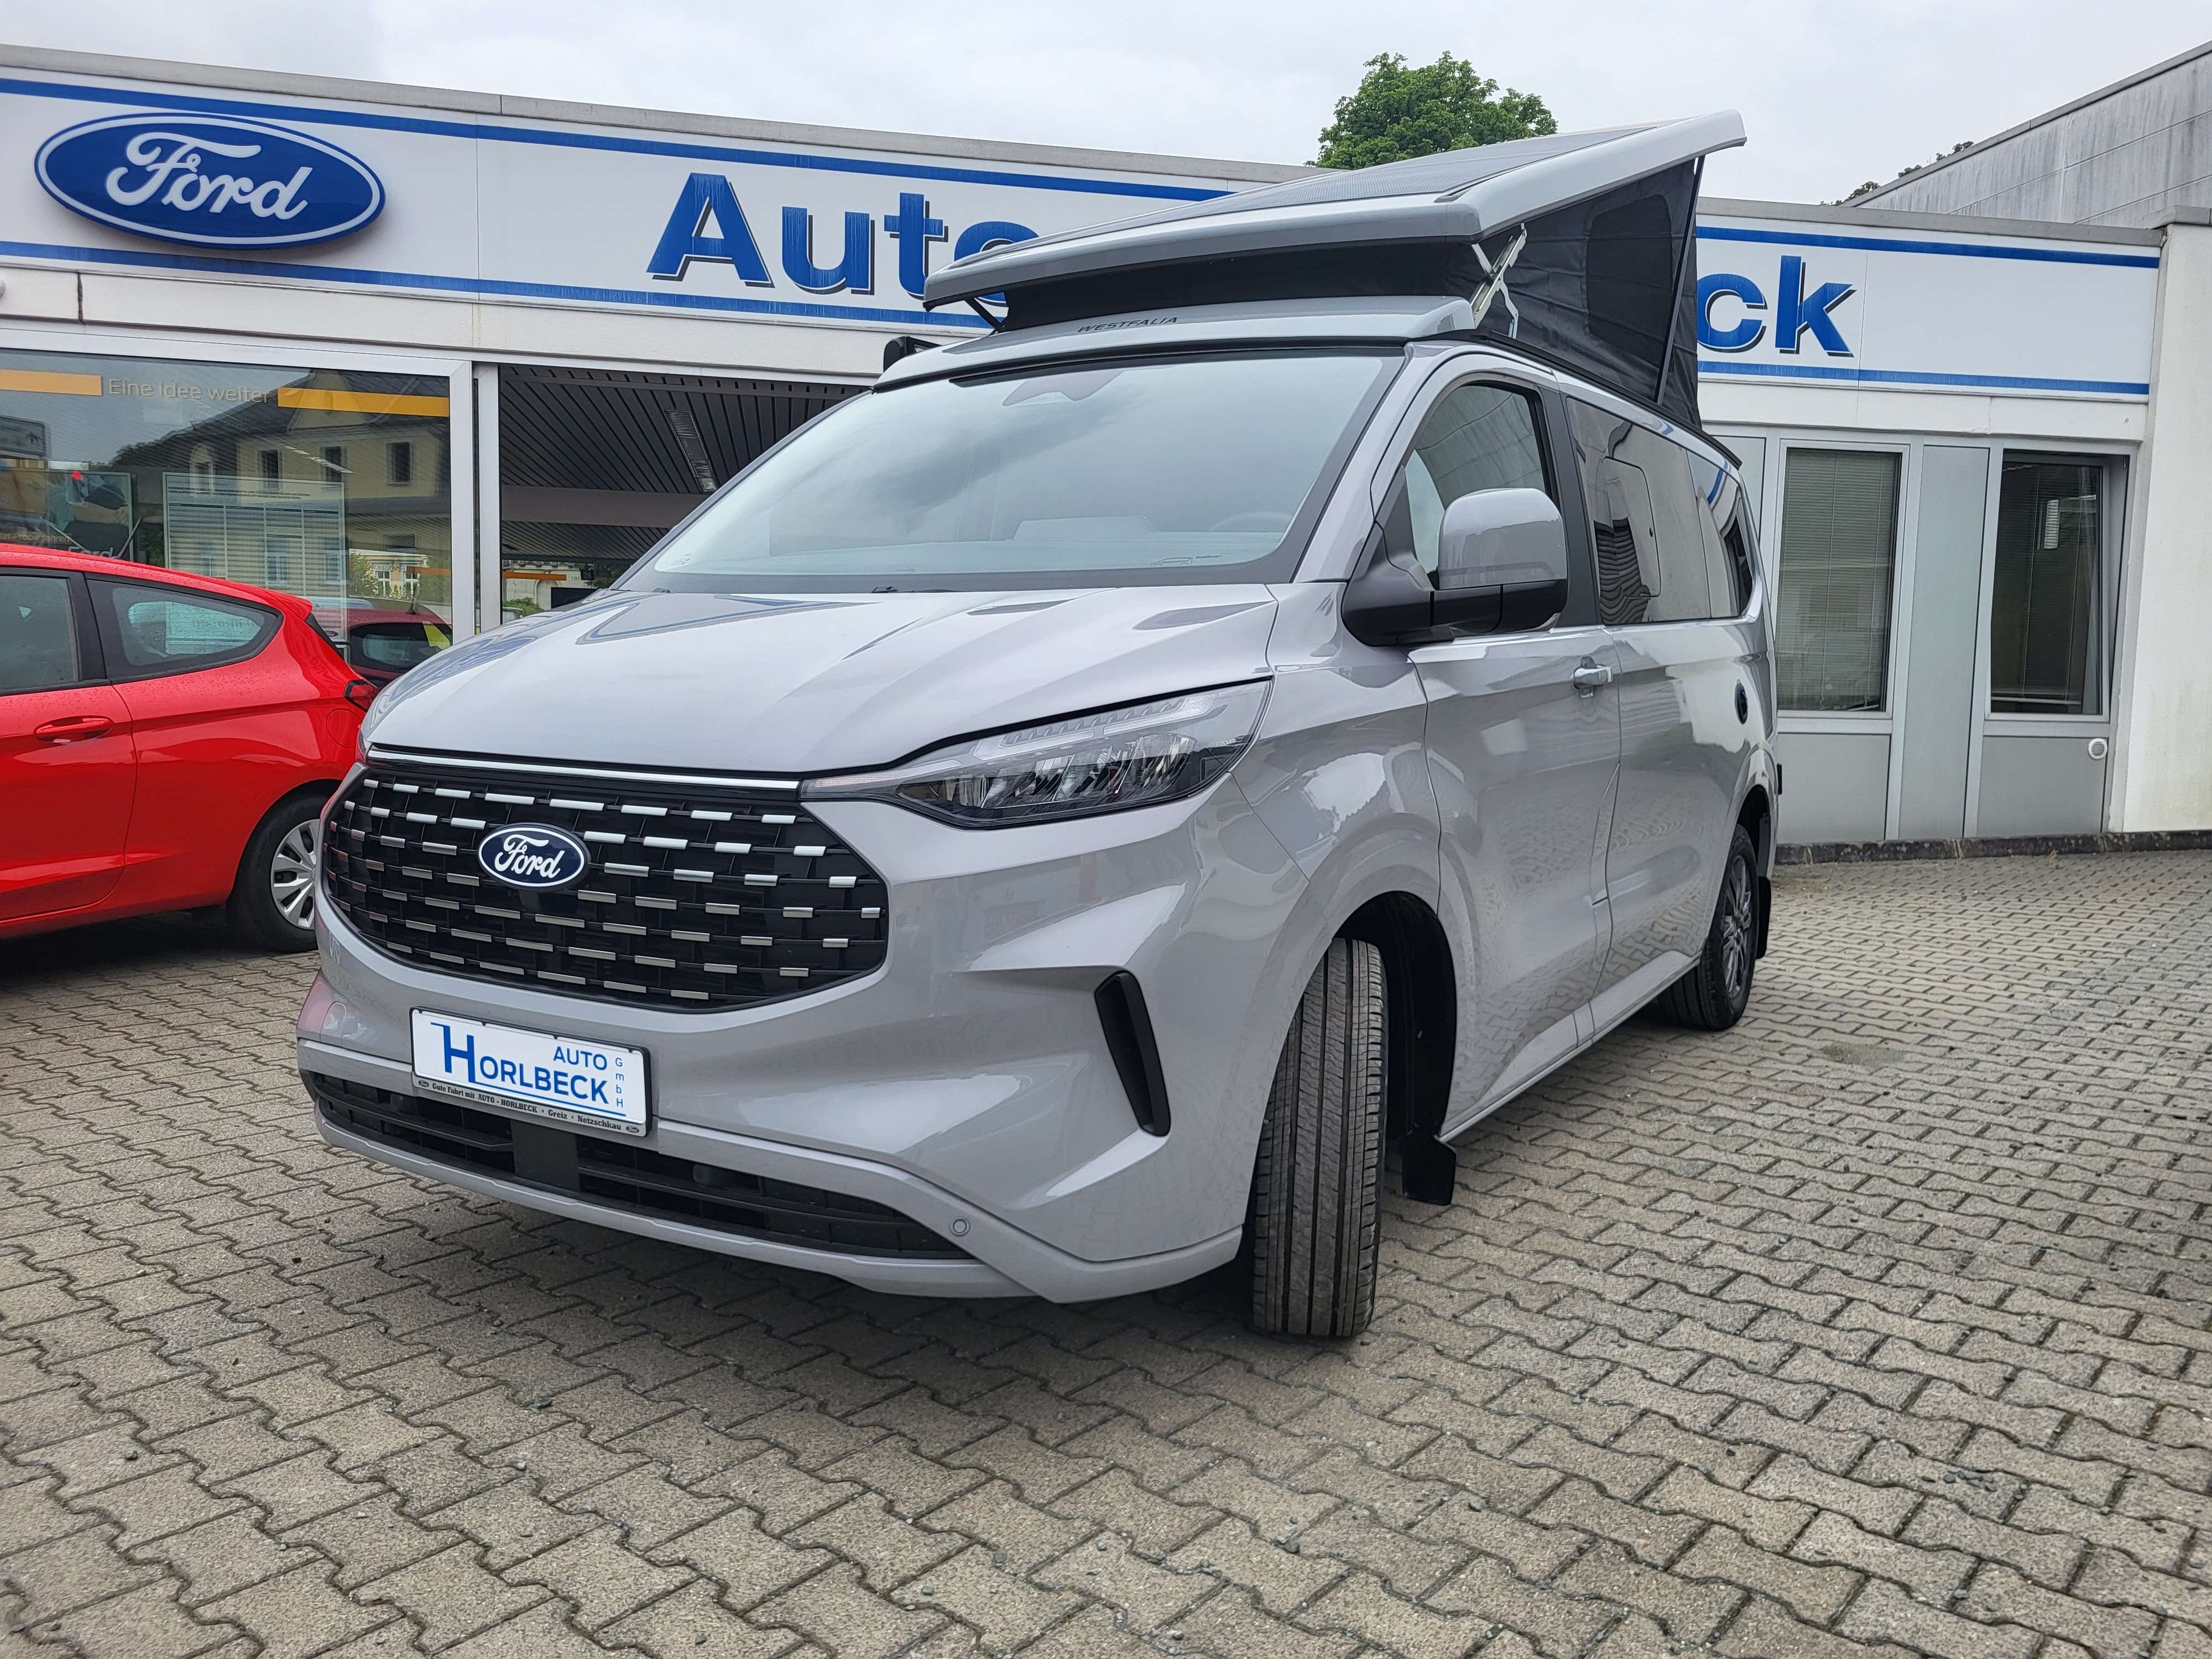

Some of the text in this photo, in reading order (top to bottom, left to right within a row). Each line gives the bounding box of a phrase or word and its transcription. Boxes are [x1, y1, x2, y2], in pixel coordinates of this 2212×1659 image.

[106, 132, 313, 220] Ford
[1077, 316, 1177, 333] WESTFALIA
[109, 378, 269, 403] Eine Idee weiter
[13, 533, 40, 541] Probe
[494, 834, 566, 879] Ford
[430, 1022, 609, 1104] HORLBECK
[553, 1046, 608, 1071] AUTO
[615, 1057, 624, 1108] GmbH
[432, 1083, 446, 1093] Gute
[447, 1087, 463, 1097] Fahrt
[478, 1093, 494, 1103] AUTO
[500, 1099, 538, 1113] HORLBECK
[548, 1109, 567, 1119] Greiz
[577, 1115, 622, 1130] Netzschkau
